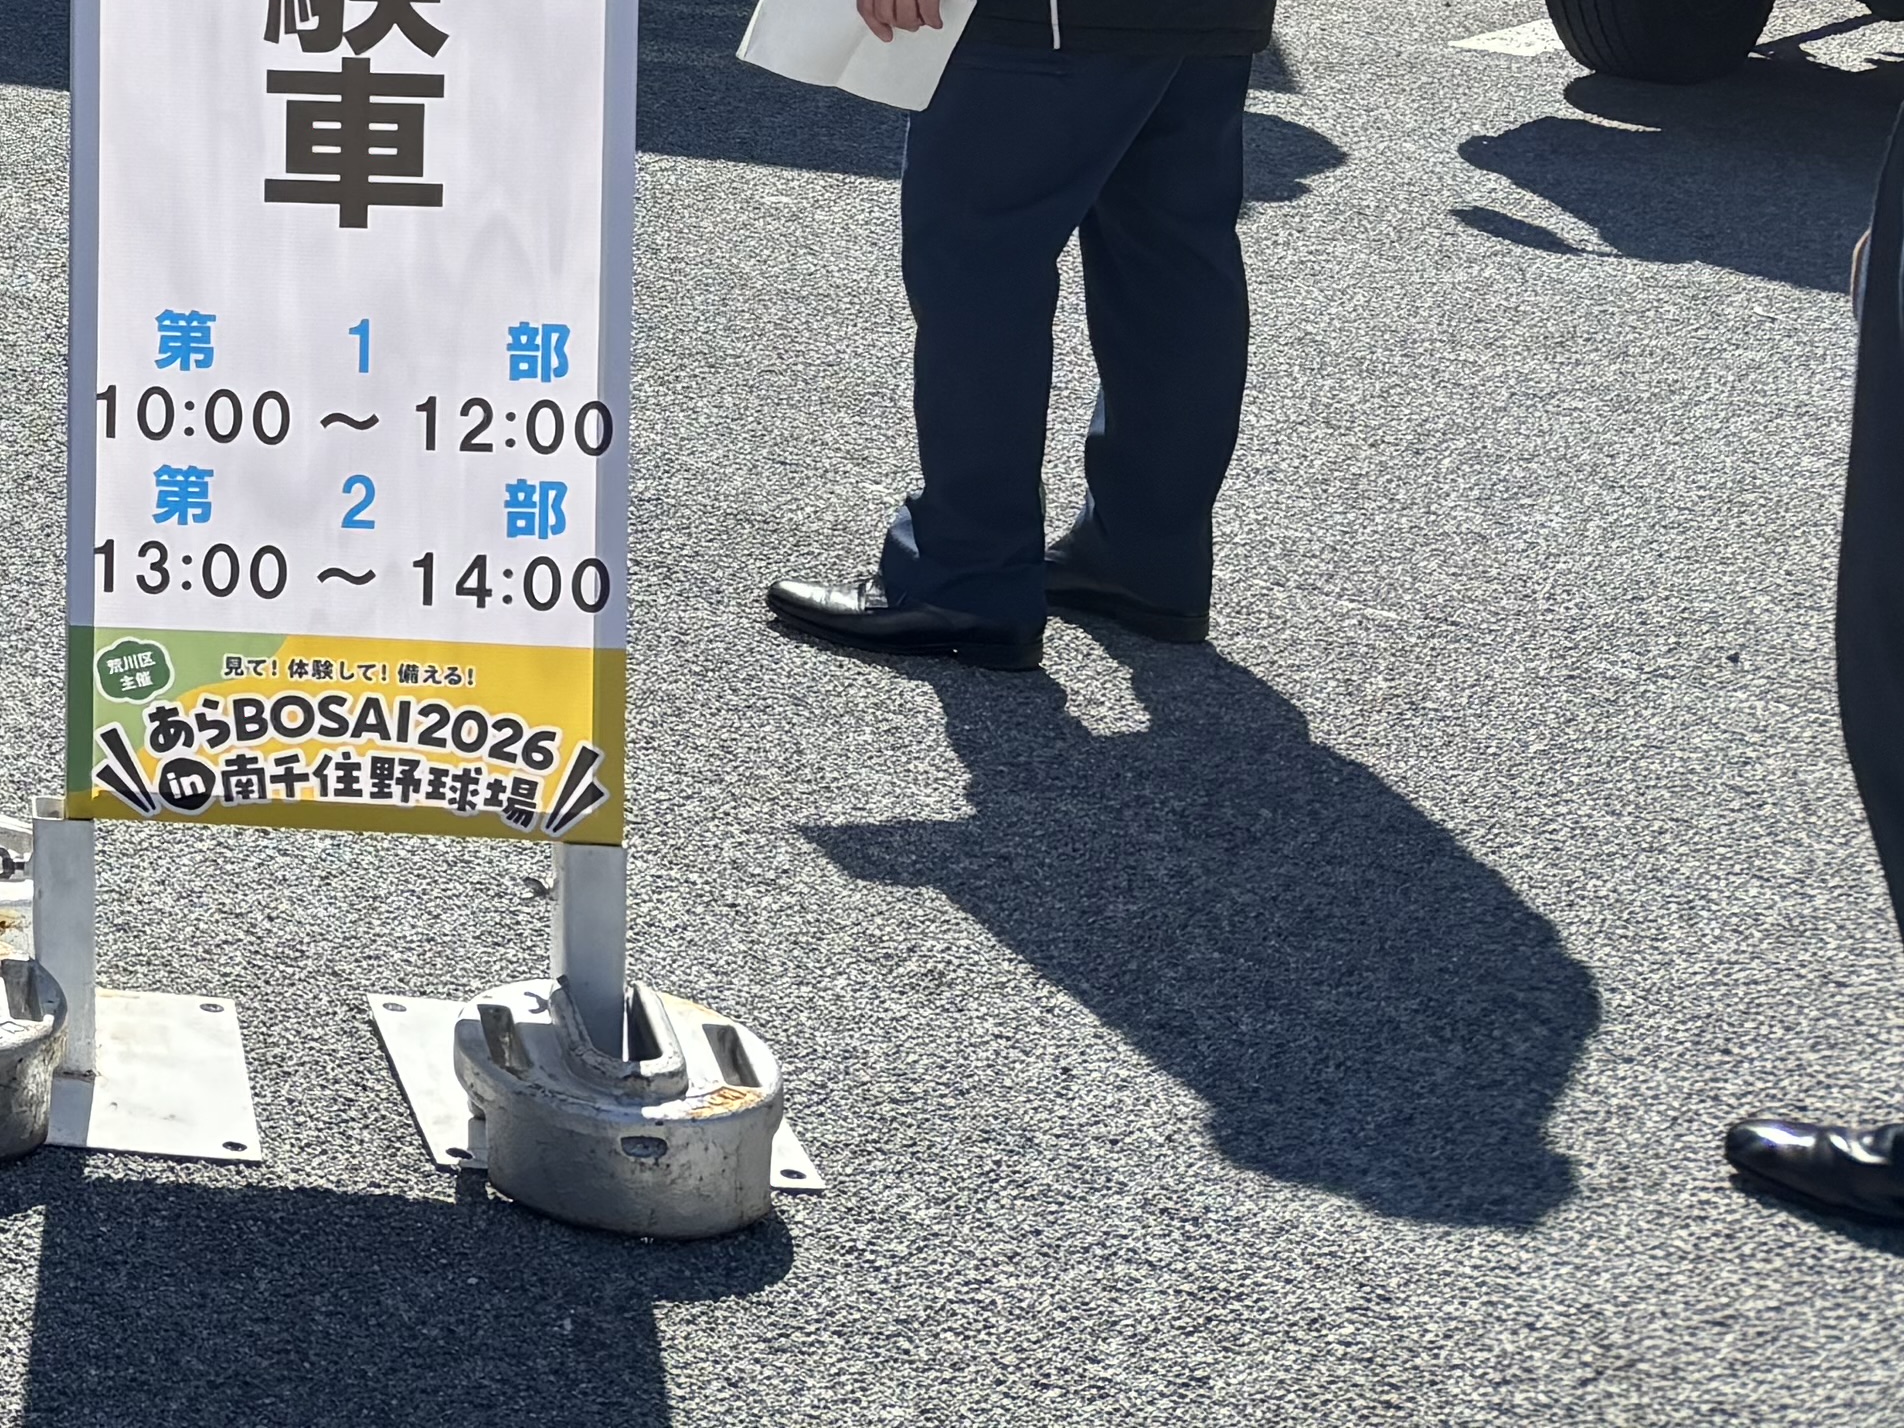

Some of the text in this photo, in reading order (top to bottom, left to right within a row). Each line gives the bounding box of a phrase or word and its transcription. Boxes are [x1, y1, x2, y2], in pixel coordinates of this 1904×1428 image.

[154, 309, 571, 383] 第 1 部
[96, 384, 291, 446] 10:00
[415, 396, 613, 456] 12:00
[151, 464, 568, 540] 第 2 部
[93, 538, 288, 600] 13:00
[412, 552, 611, 613] 14:00
[107, 651, 157, 674] 荒川区
[120, 670, 153, 691] 主催
[148, 696, 558, 772] あらBOSAI2026
